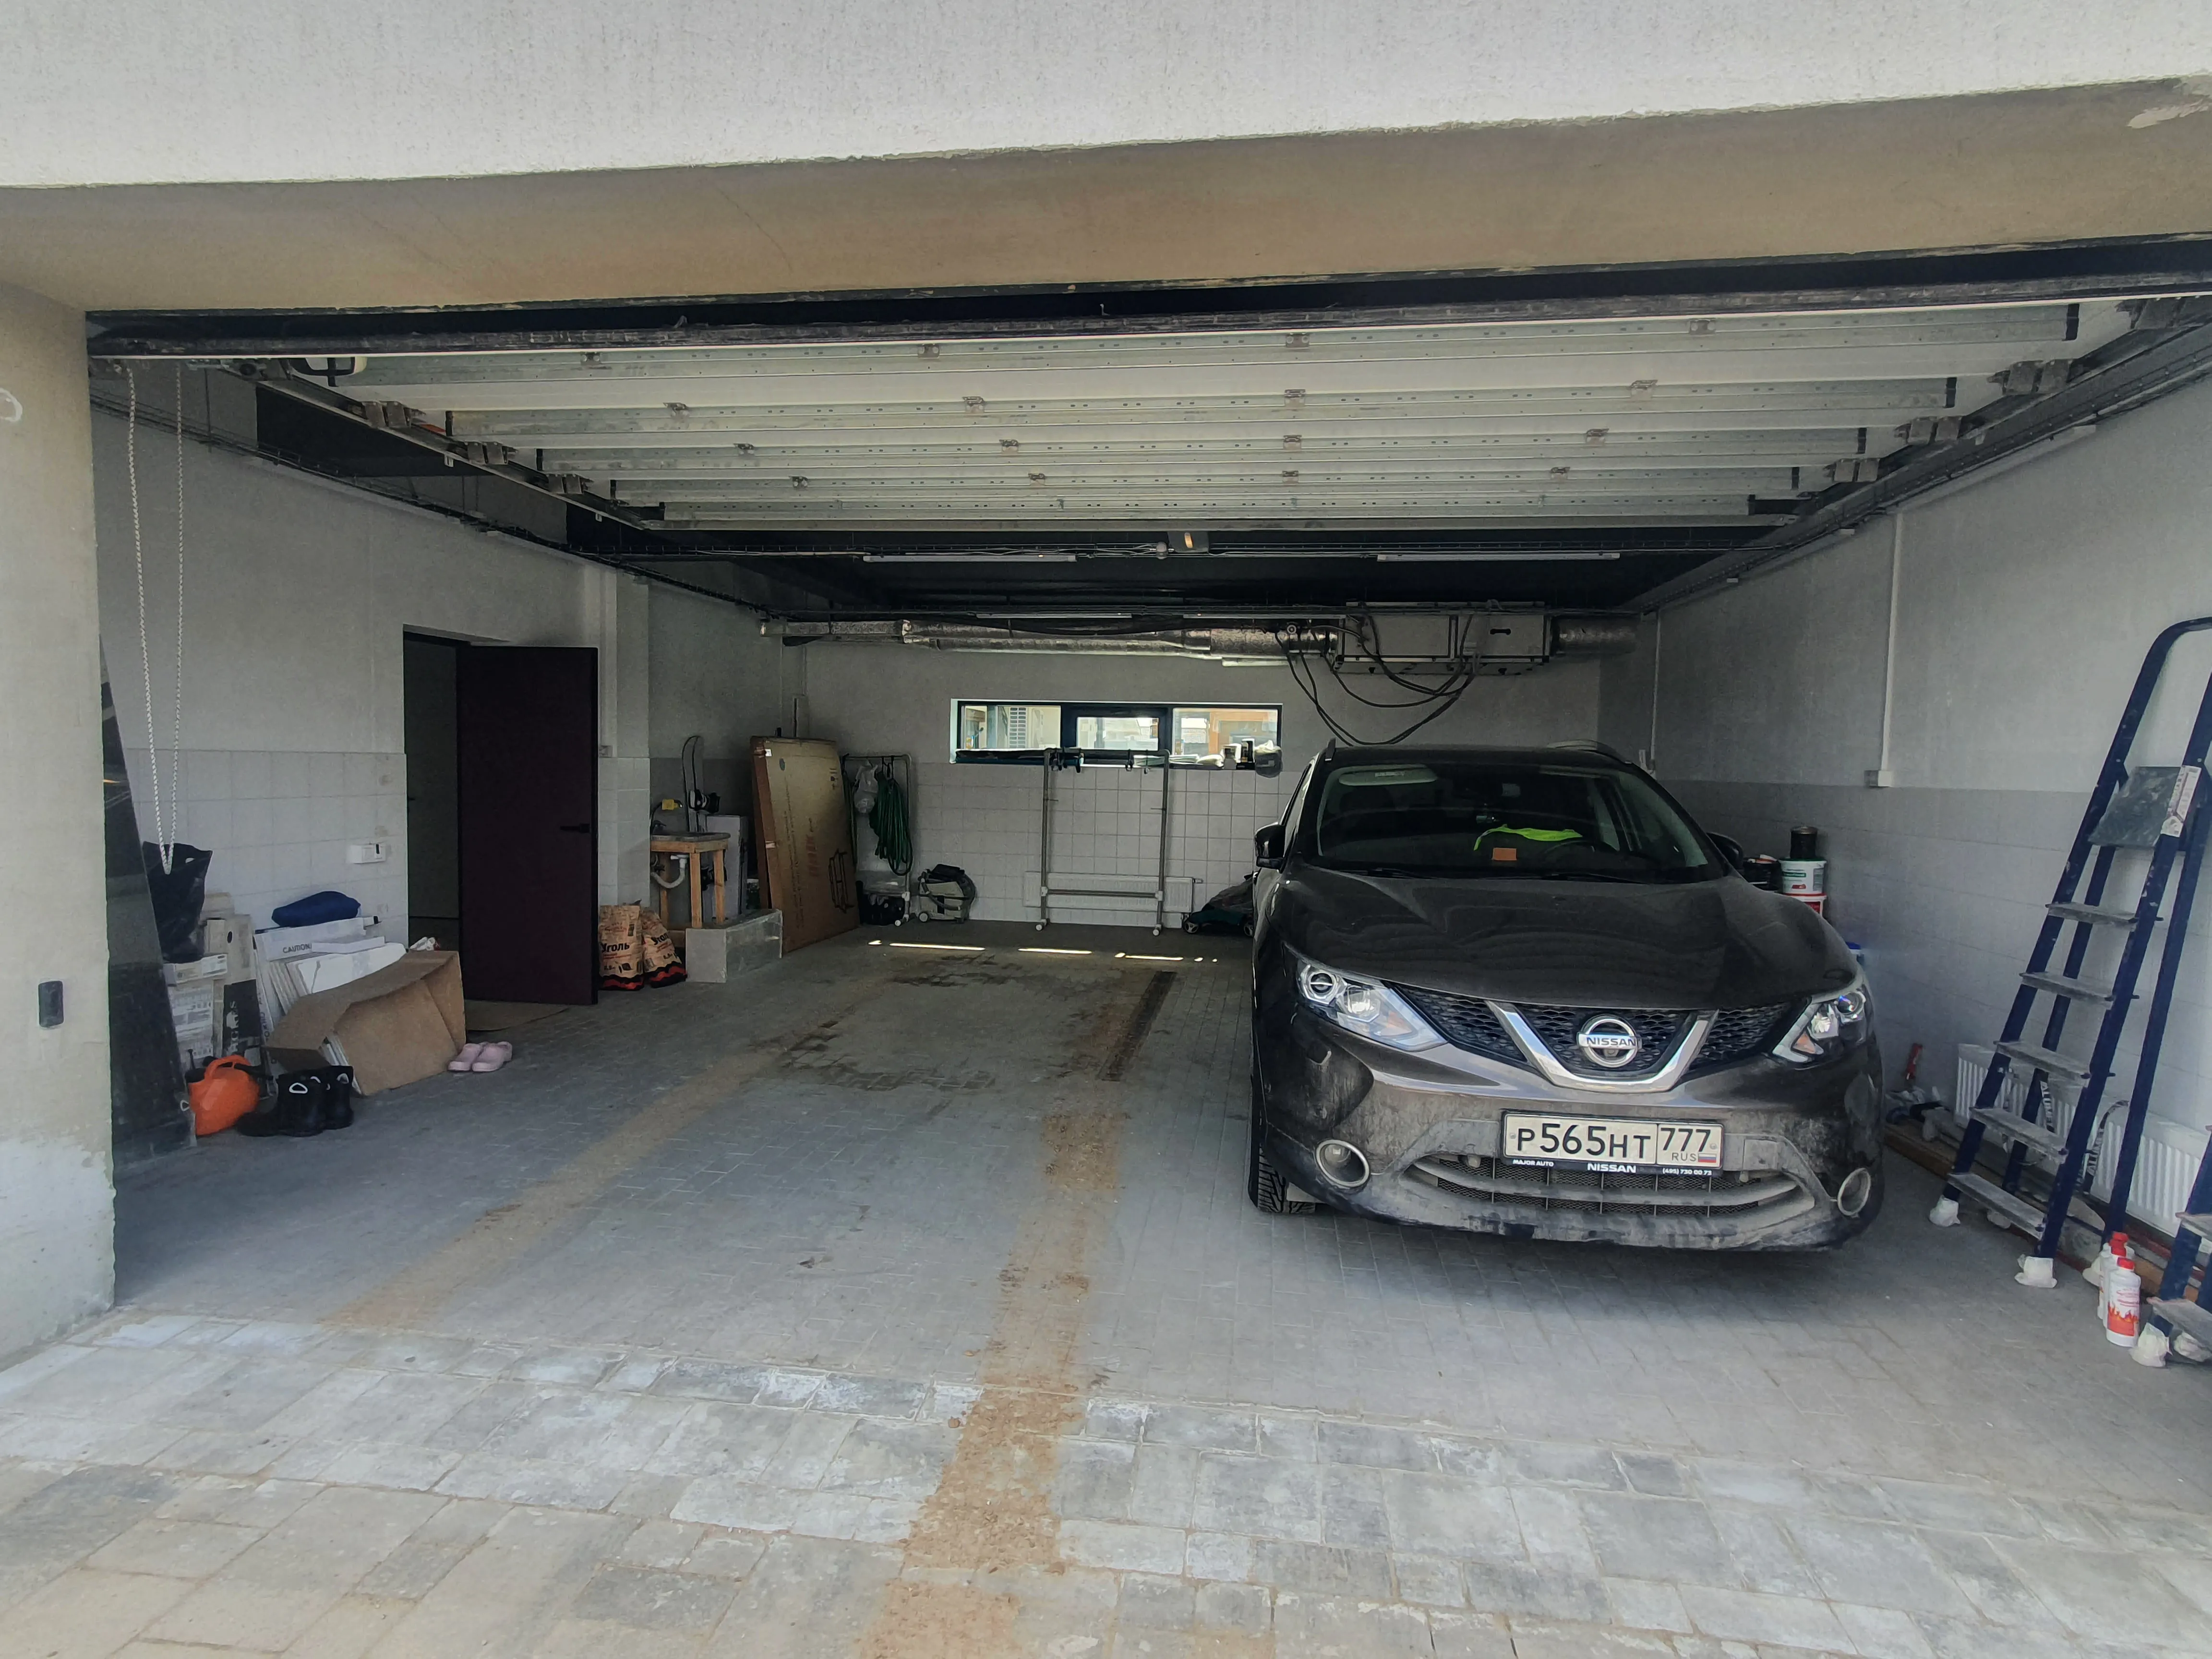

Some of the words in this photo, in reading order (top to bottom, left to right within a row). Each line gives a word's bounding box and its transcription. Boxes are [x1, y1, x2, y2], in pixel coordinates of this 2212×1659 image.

[1586, 1037, 1636, 1046] NISSAN
[1660, 1128, 1711, 1152] 777
[1671, 1153, 1697, 1162] RUS
[1587, 1163, 1636, 1173] NISSAN
